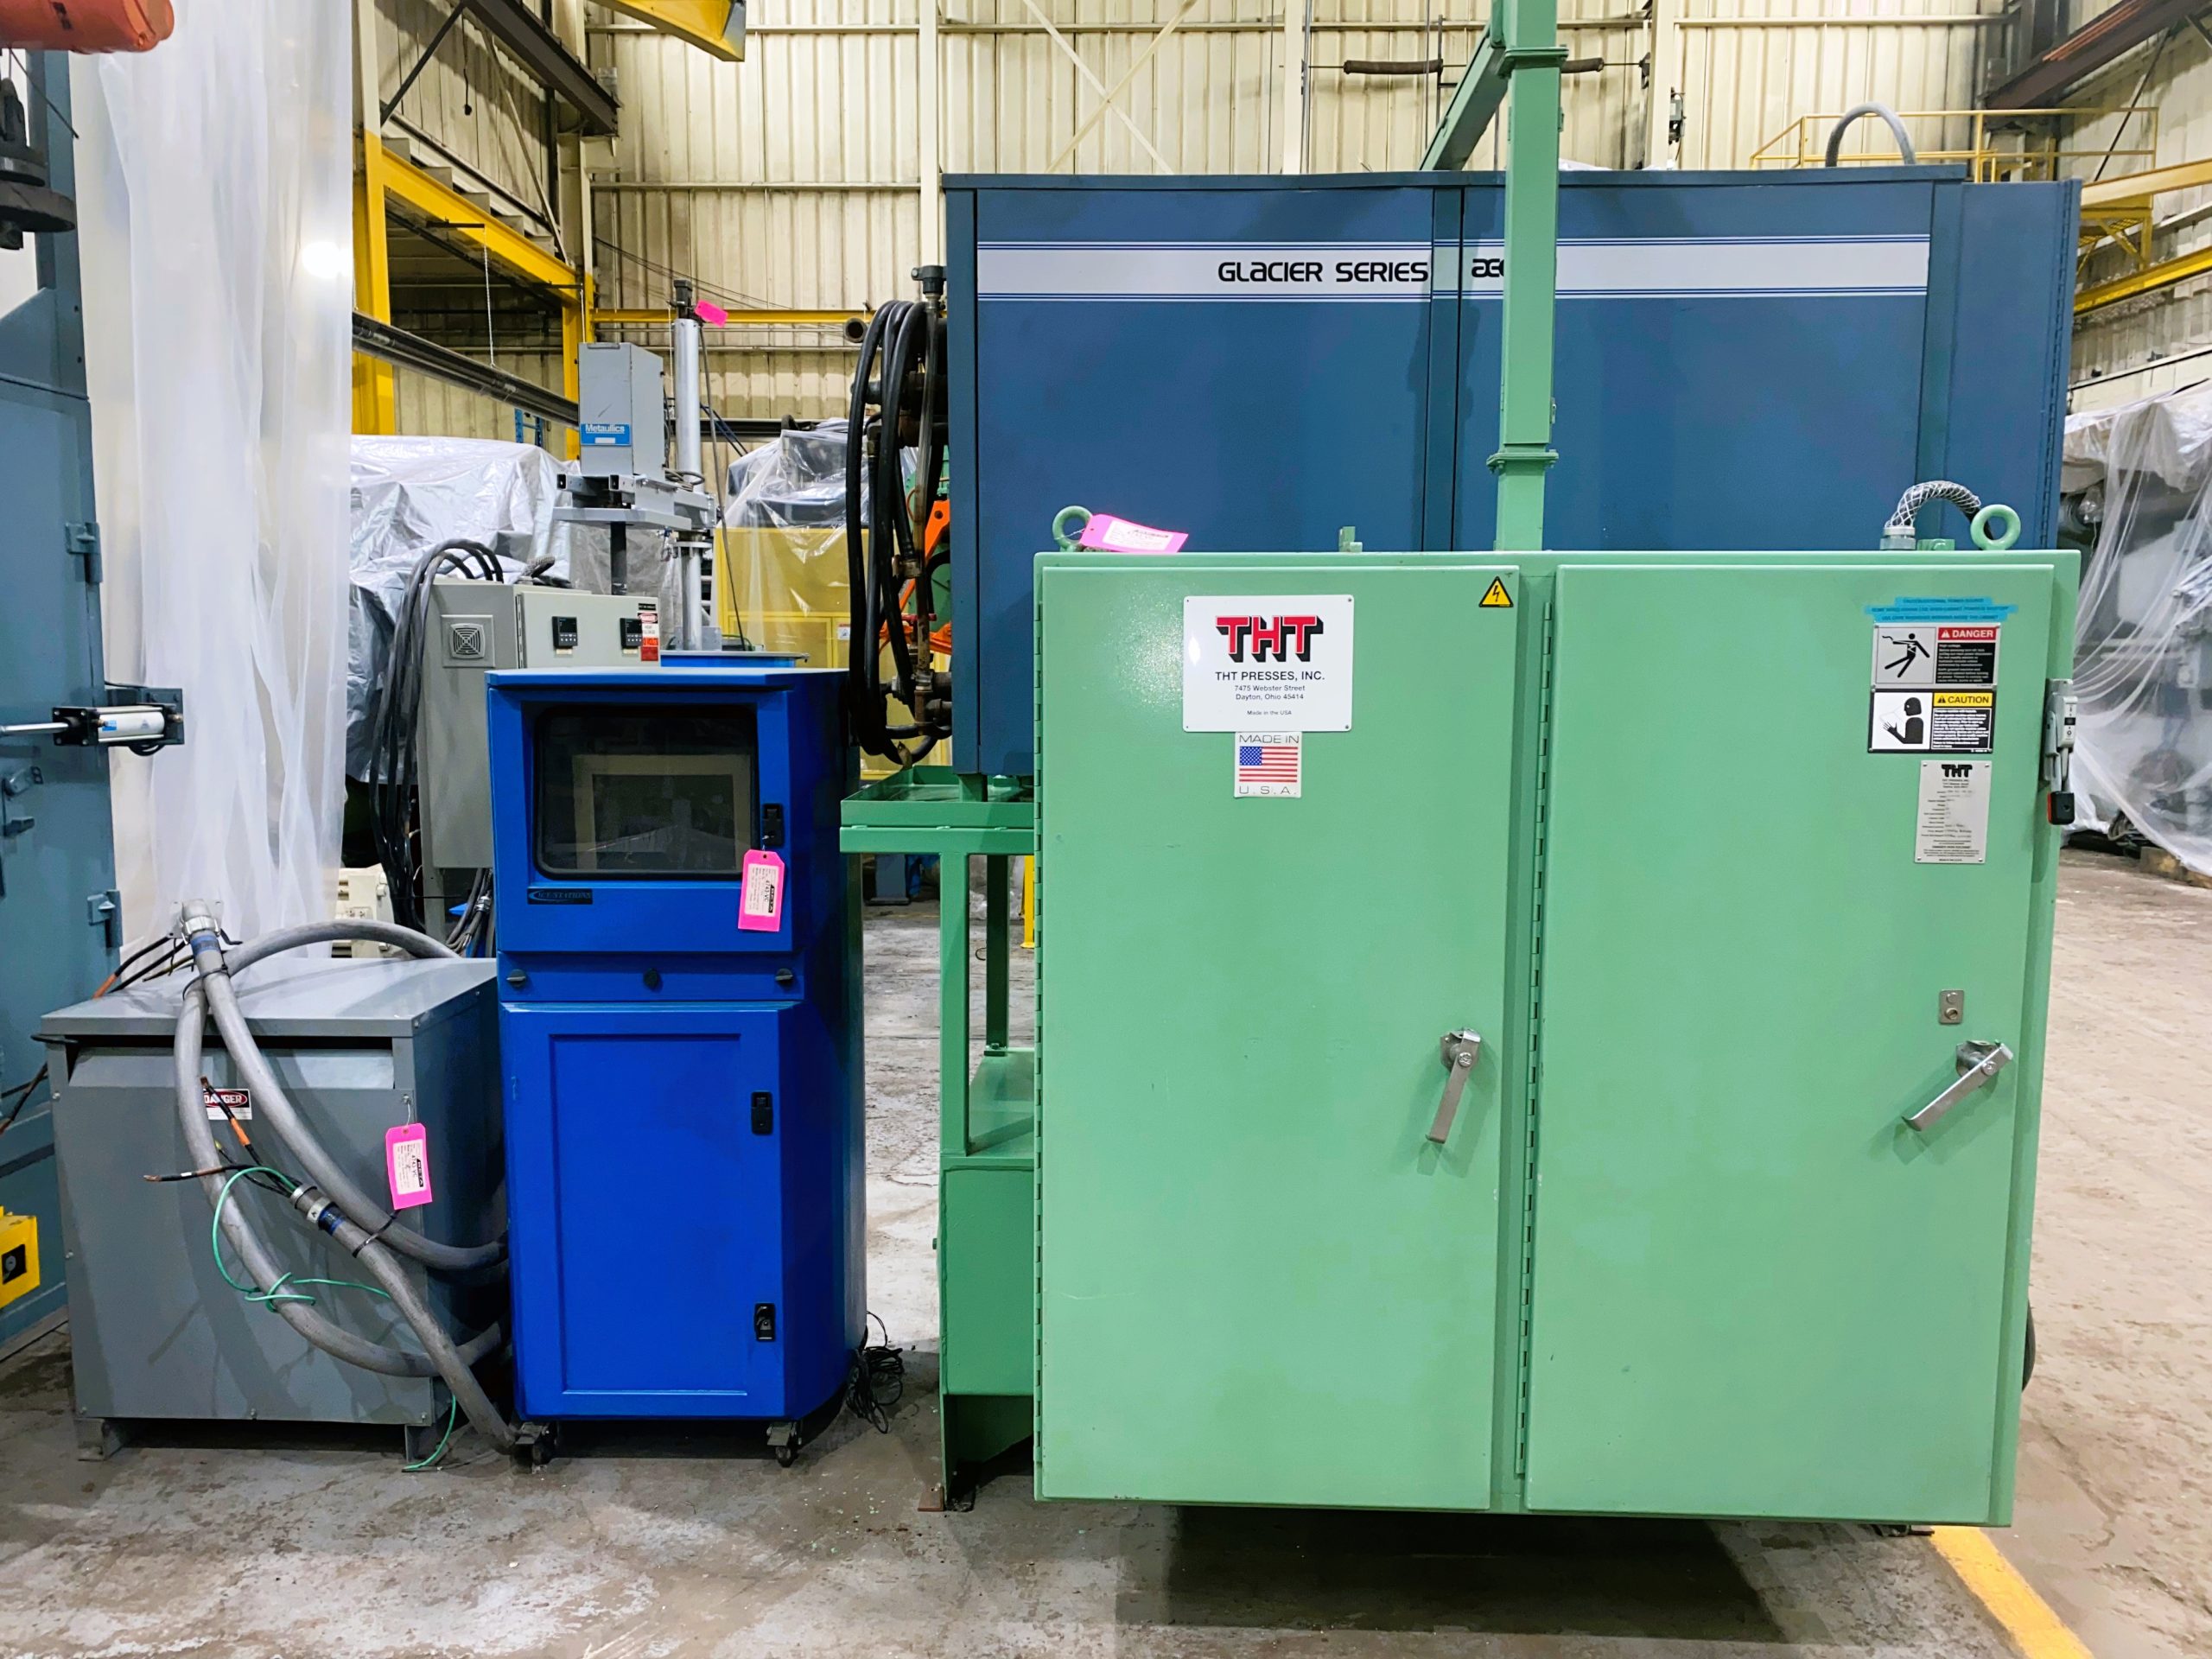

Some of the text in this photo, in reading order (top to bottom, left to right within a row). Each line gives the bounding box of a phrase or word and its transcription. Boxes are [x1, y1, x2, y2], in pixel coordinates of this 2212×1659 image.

[1218, 261, 1428, 283] GLACIER SERIES
[1215, 614, 1324, 663] THT
[1215, 671, 1325, 682] THT PRESSES, INC.
[1948, 696, 1989, 704] CAUTION
[1239, 734, 1300, 744] MADE IN
[1941, 764, 1974, 778] THT
